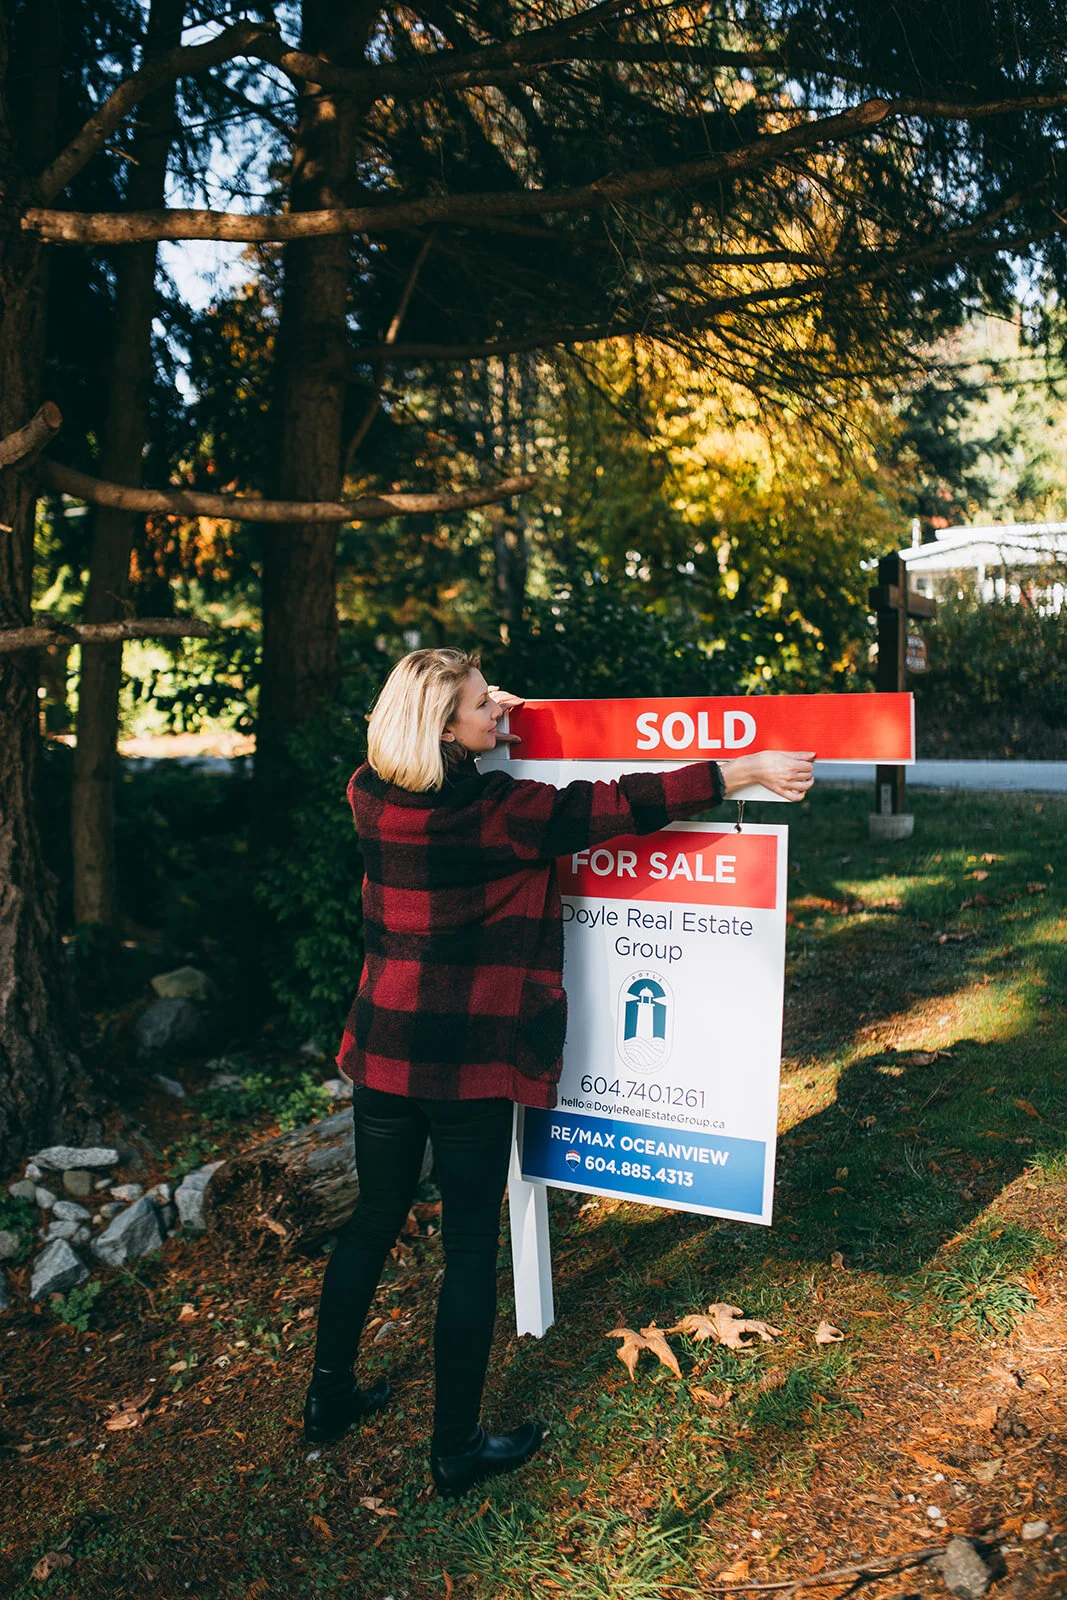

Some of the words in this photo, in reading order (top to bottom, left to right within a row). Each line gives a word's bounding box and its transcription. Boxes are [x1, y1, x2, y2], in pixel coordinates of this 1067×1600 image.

[636, 711, 756, 751] SOLD
[572, 849, 638, 878] FOR
[648, 852, 736, 884] SALE
[562, 904, 618, 928] Doyle
[627, 908, 672, 930] Real
[683, 912, 753, 936] Estate
[615, 936, 683, 963] Group
[631, 972, 663, 983] DOYLE
[580, 1074, 705, 1109] 604.740.1261
[561, 1096, 725, 1130] hello@DoyleRealEstateGroup.ca
[551, 1125, 615, 1149] RE/MAX
[620, 1136, 730, 1166] OCEANVIEW
[584, 1155, 693, 1187] 604.885.4313
